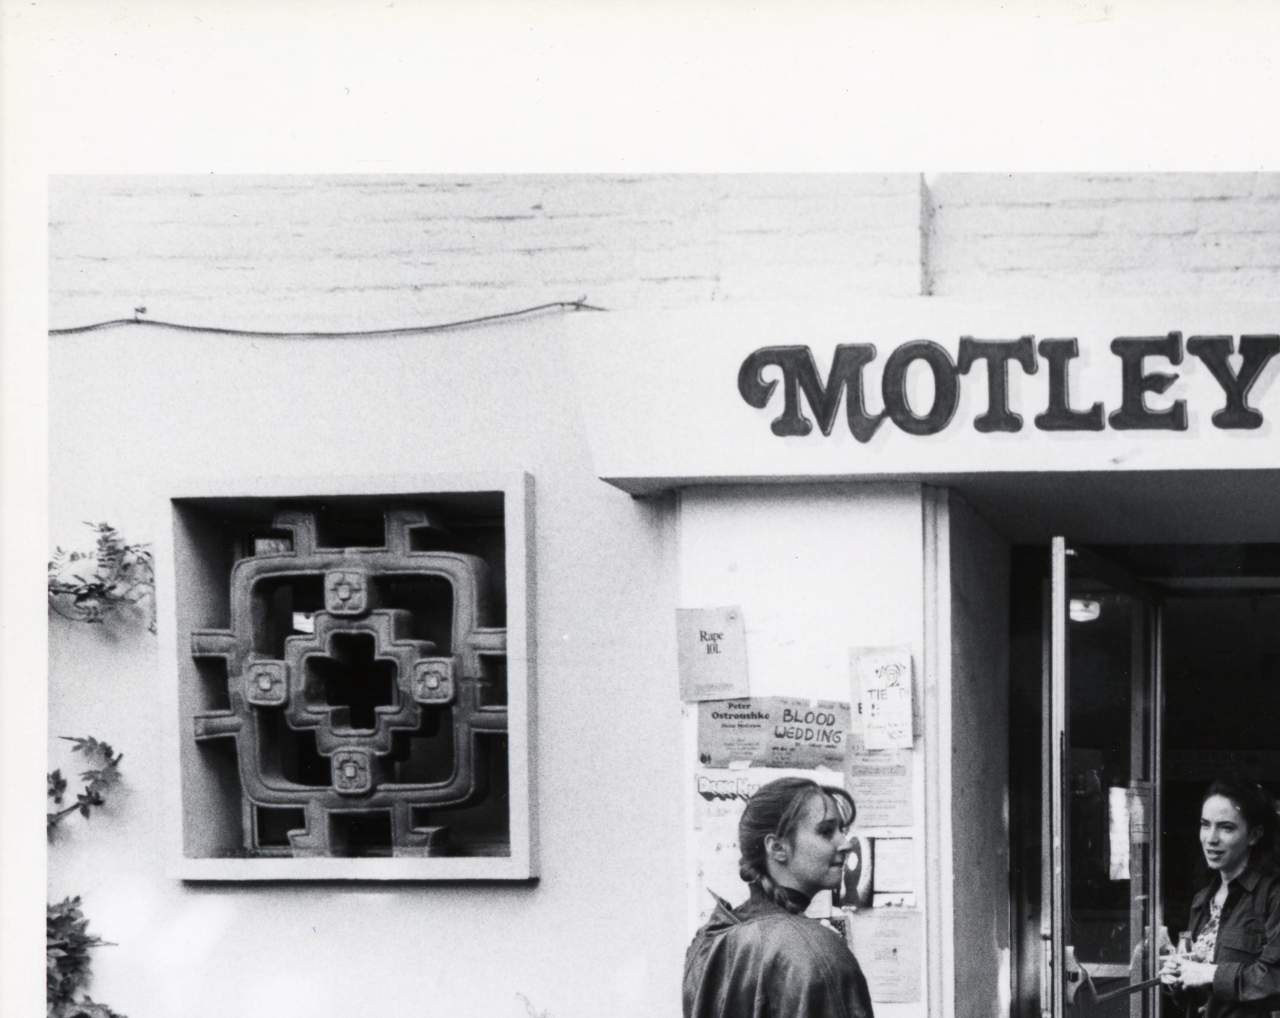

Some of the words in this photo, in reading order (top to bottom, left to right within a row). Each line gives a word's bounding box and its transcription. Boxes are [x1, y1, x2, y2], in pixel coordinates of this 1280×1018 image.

[699, 630, 724, 643] Rape
[867, 689, 888, 700] TIE
[728, 702, 751, 710] Peter
[782, 708, 836, 727] BLOOD
[774, 725, 842, 744] WEDDING
